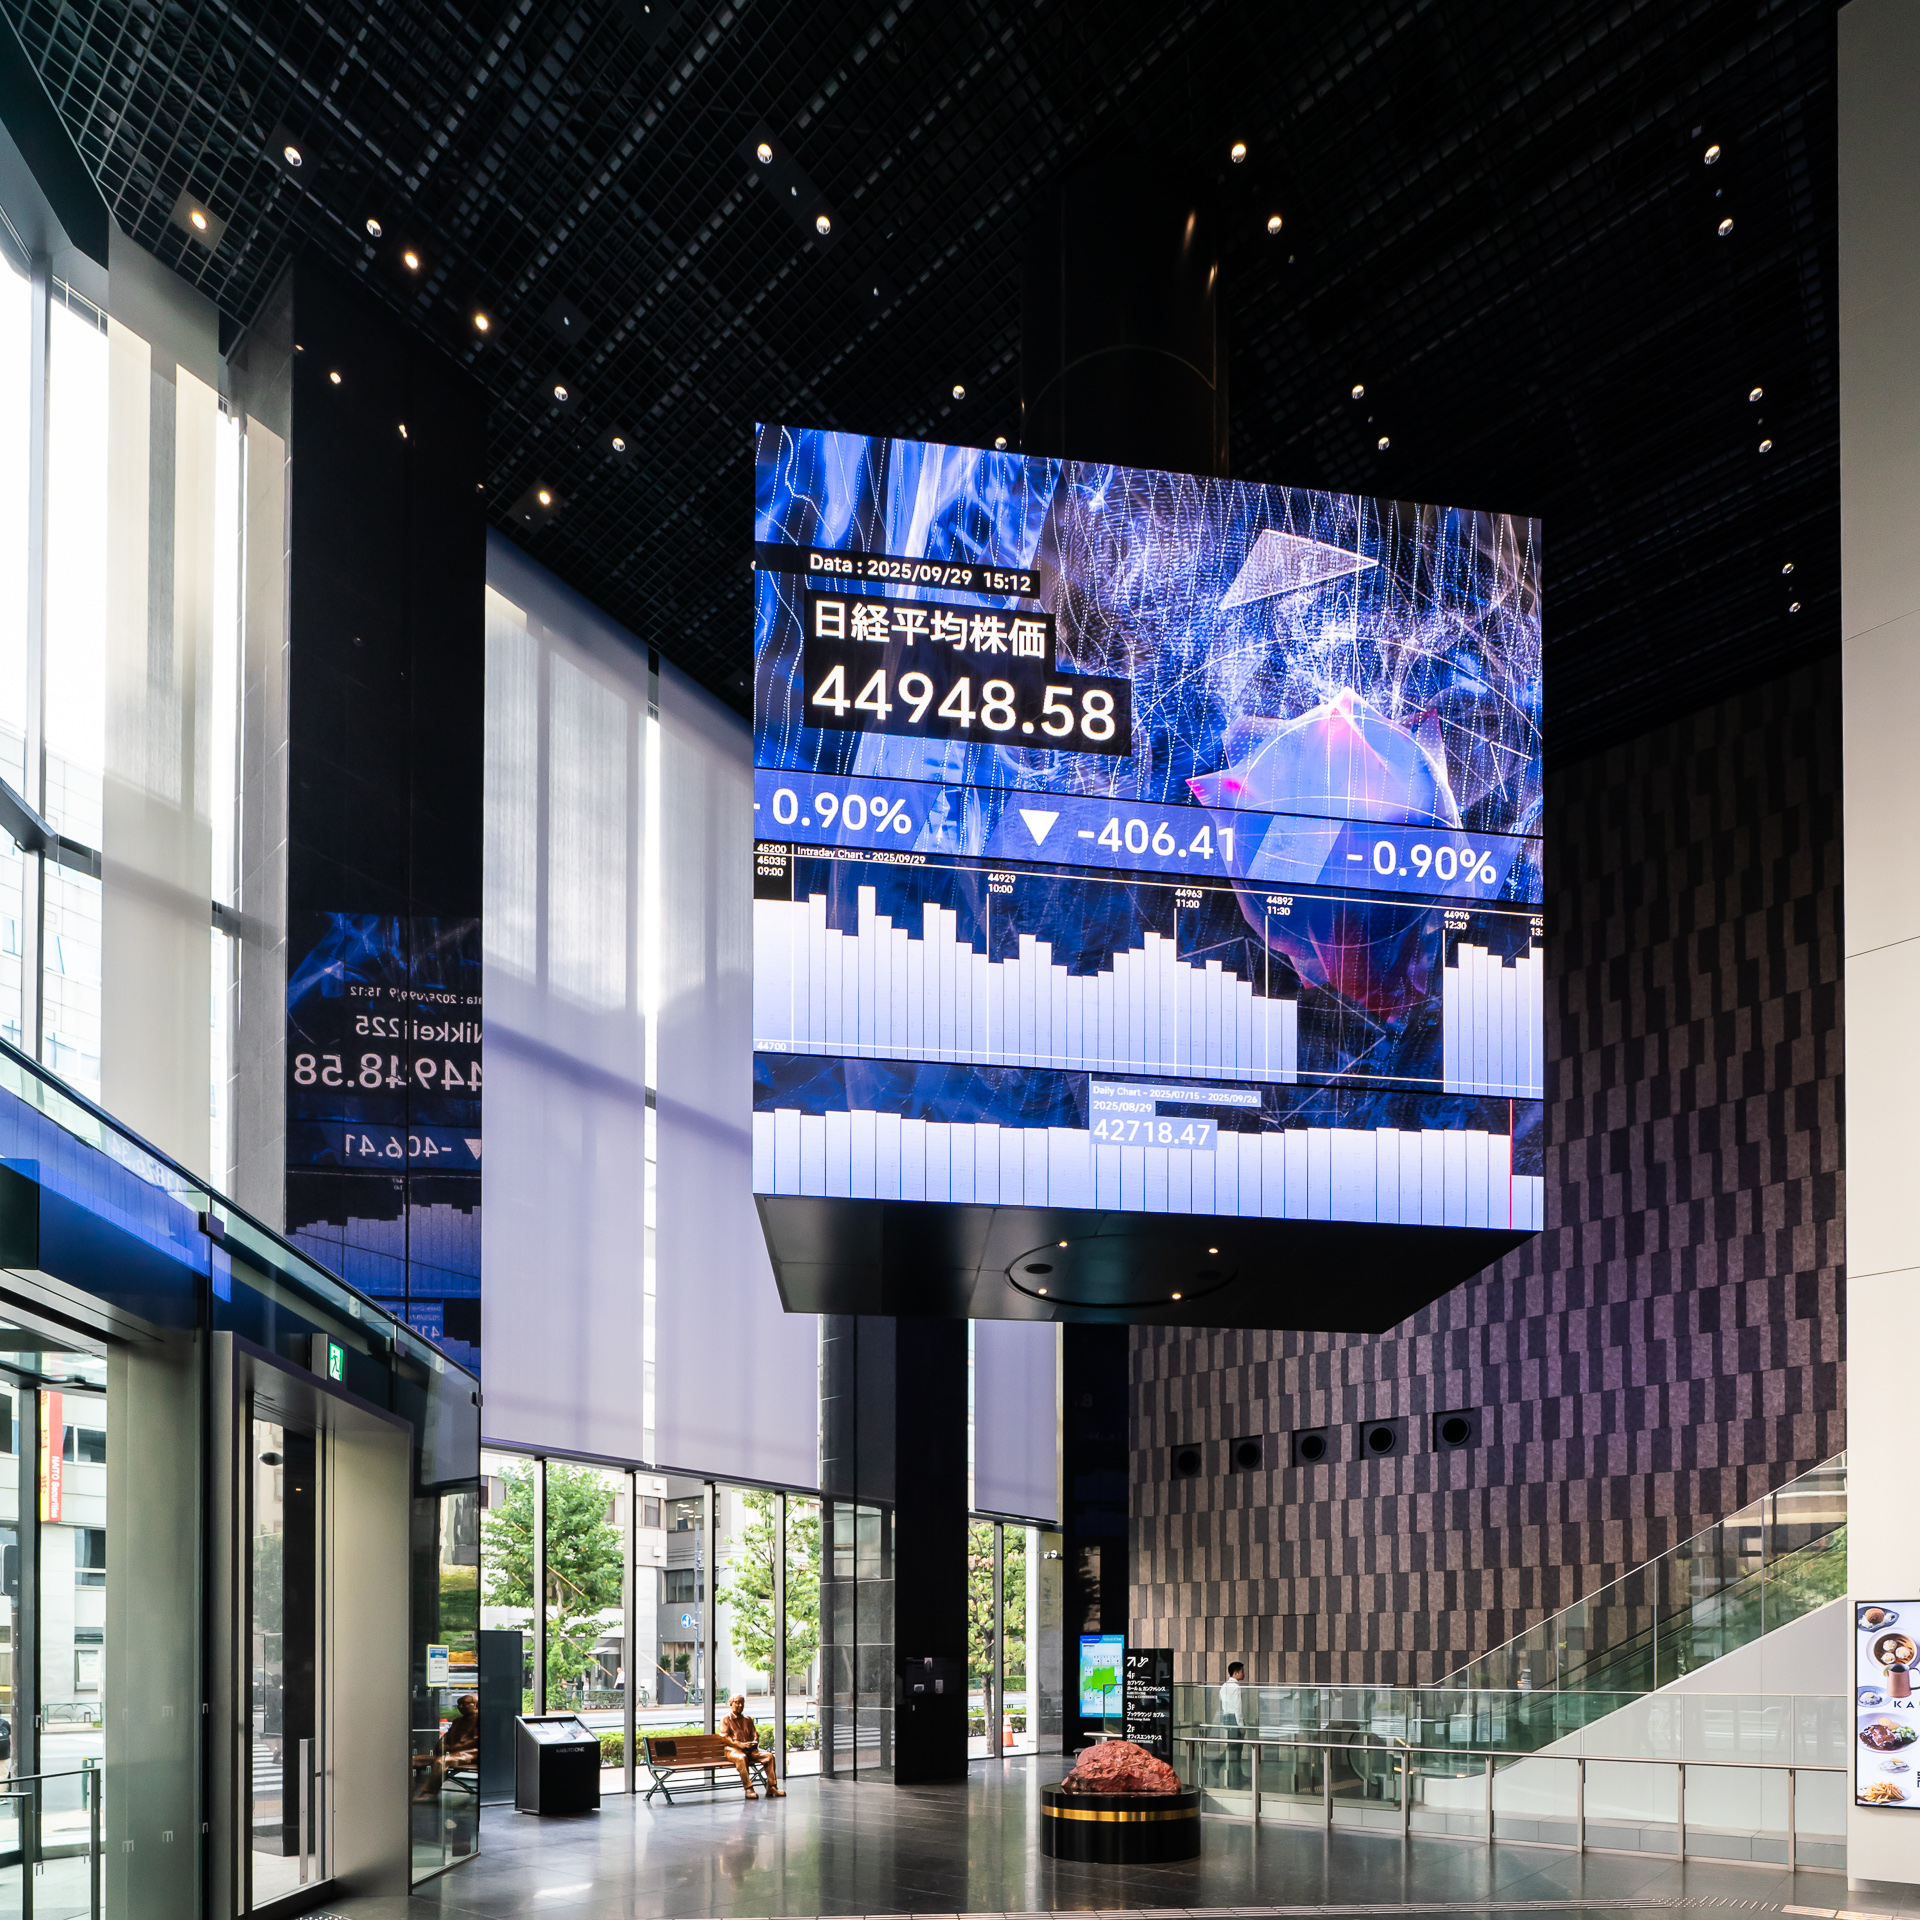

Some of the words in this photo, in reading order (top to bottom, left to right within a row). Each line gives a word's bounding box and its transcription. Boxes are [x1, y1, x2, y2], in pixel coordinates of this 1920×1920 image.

[810, 553, 853, 573] Data
[867, 559, 973, 586] 2025/09/29
[983, 572, 1031, 592] 15:12
[815, 599, 1047, 659] 日経平均株価
[812, 664, 1116, 741] 44948.58
[1077, 817, 1235, 862] -406.41
[757, 843, 787, 854] 45200
[797, 846, 836, 859] Intraday
[837, 850, 864, 860] Chart
[872, 852, 926, 864] 2025/09/29
[757, 855, 787, 866] 45035
[757, 867, 784, 877] 09:00
[987, 872, 1016, 884] 44929
[988, 883, 1013, 894] 10:00
[1175, 889, 1203, 899] 44963
[1175, 899, 1200, 909] 11:00
[1266, 895, 1293, 906] 44892
[1267, 905, 1291, 916] 11:30
[1443, 910, 1470, 920] 44996
[1444, 920, 1467, 930] 12:30
[757, 1041, 787, 1051] 44700
[1092, 1085, 1116, 1096] Daily
[1117, 1087, 1141, 1097] Chart
[1149, 1090, 1200, 1100] 2025/07/15
[1207, 1093, 1258, 1104] 2025/09/26
[1093, 1101, 1152, 1113] 2025/08/29
[1093, 1118, 1211, 1146] 42718.47
[52, 1456, 60, 1480] NAITO
[51, 1481, 60, 1518] Securities
[1127, 1671, 1135, 1679] 4F
[1127, 1702, 1135, 1711] 3F
[1894, 1701, 1920, 1709] KA
[1127, 1724, 1135, 1733] 2F
